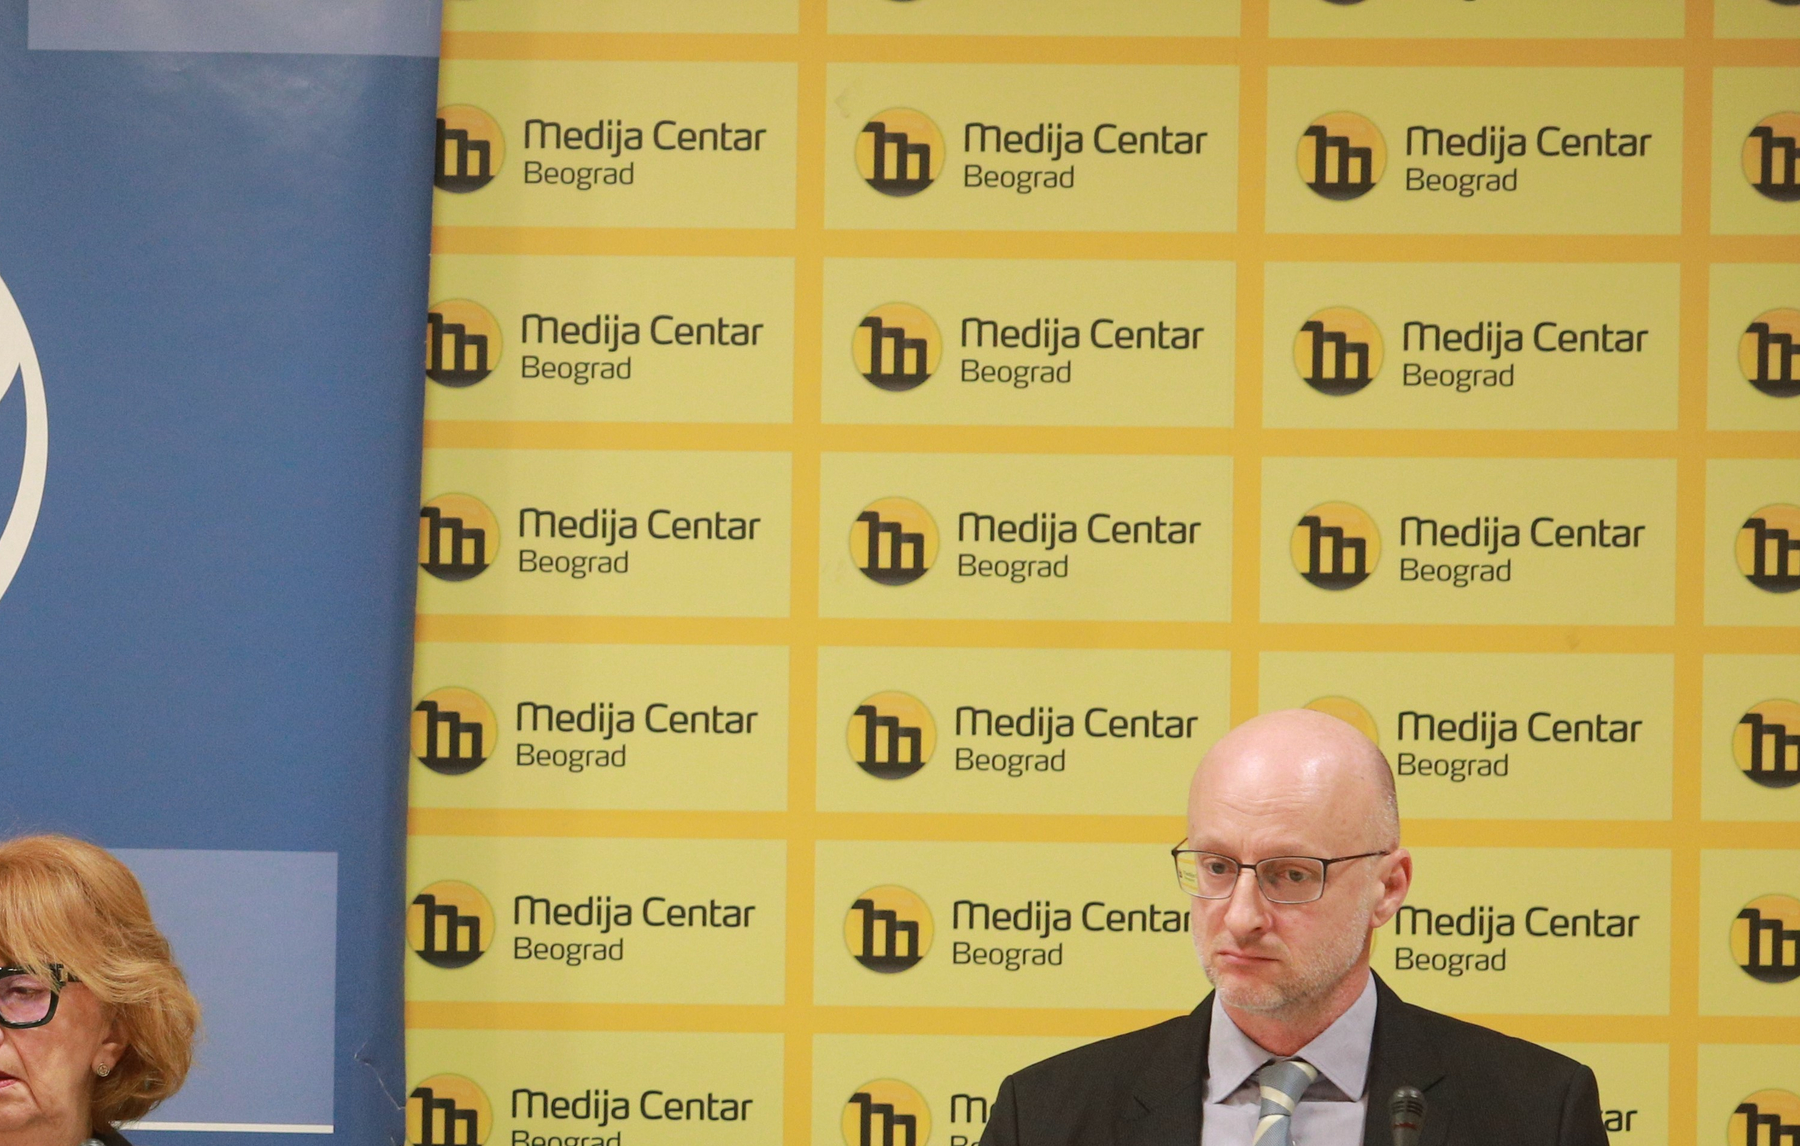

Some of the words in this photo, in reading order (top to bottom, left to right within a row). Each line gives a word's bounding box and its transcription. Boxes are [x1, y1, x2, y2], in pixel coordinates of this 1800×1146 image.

[524, 118, 643, 158] Medija
[653, 119, 767, 152] Centar
[964, 122, 1084, 162] Medija
[1093, 123, 1209, 155] Centar
[1406, 125, 1527, 165] Medija
[1536, 125, 1653, 158] Centar
[524, 160, 634, 191] Beograd
[964, 164, 1075, 195] Beograd
[1406, 167, 1518, 198] Beograd
[521, 313, 640, 353] Medija
[650, 314, 764, 347] Centar
[961, 317, 1081, 357] Medija
[1090, 318, 1205, 350] Centar
[1403, 320, 1524, 360] Medija
[1533, 321, 1649, 353] Centar
[521, 354, 632, 386] Beograd
[961, 358, 1072, 390] Beograd
[1403, 362, 1515, 393] Beograd
[519, 507, 638, 547] Medija
[647, 508, 762, 541] Centar
[958, 511, 1078, 551] Medija
[1087, 512, 1202, 545] Centar
[1400, 515, 1521, 555] Medija
[1530, 516, 1646, 548] Centar
[518, 549, 629, 580] Beograd
[958, 553, 1069, 584] Beograd
[1400, 557, 1512, 588] Beograd
[516, 701, 635, 741] Medija
[644, 702, 759, 735] Centar
[955, 705, 1075, 745] Medija
[1084, 707, 1199, 739] Centar
[1397, 710, 1518, 750] Medija
[1527, 711, 1643, 743] Centar
[516, 742, 626, 774] Beograd
[955, 747, 1066, 778] Beograd
[1397, 752, 1509, 783] Beograd
[513, 894, 633, 934] Medija
[642, 896, 756, 928] Centar
[952, 899, 1072, 939] Medija
[1395, 905, 1515, 945] Medija
[1525, 906, 1641, 938] Centar
[513, 936, 624, 967] Beograd
[952, 941, 1063, 972] Beograd
[1395, 946, 1506, 978] Beograd
[511, 1088, 630, 1128] Medija
[639, 1089, 754, 1122] Centar
